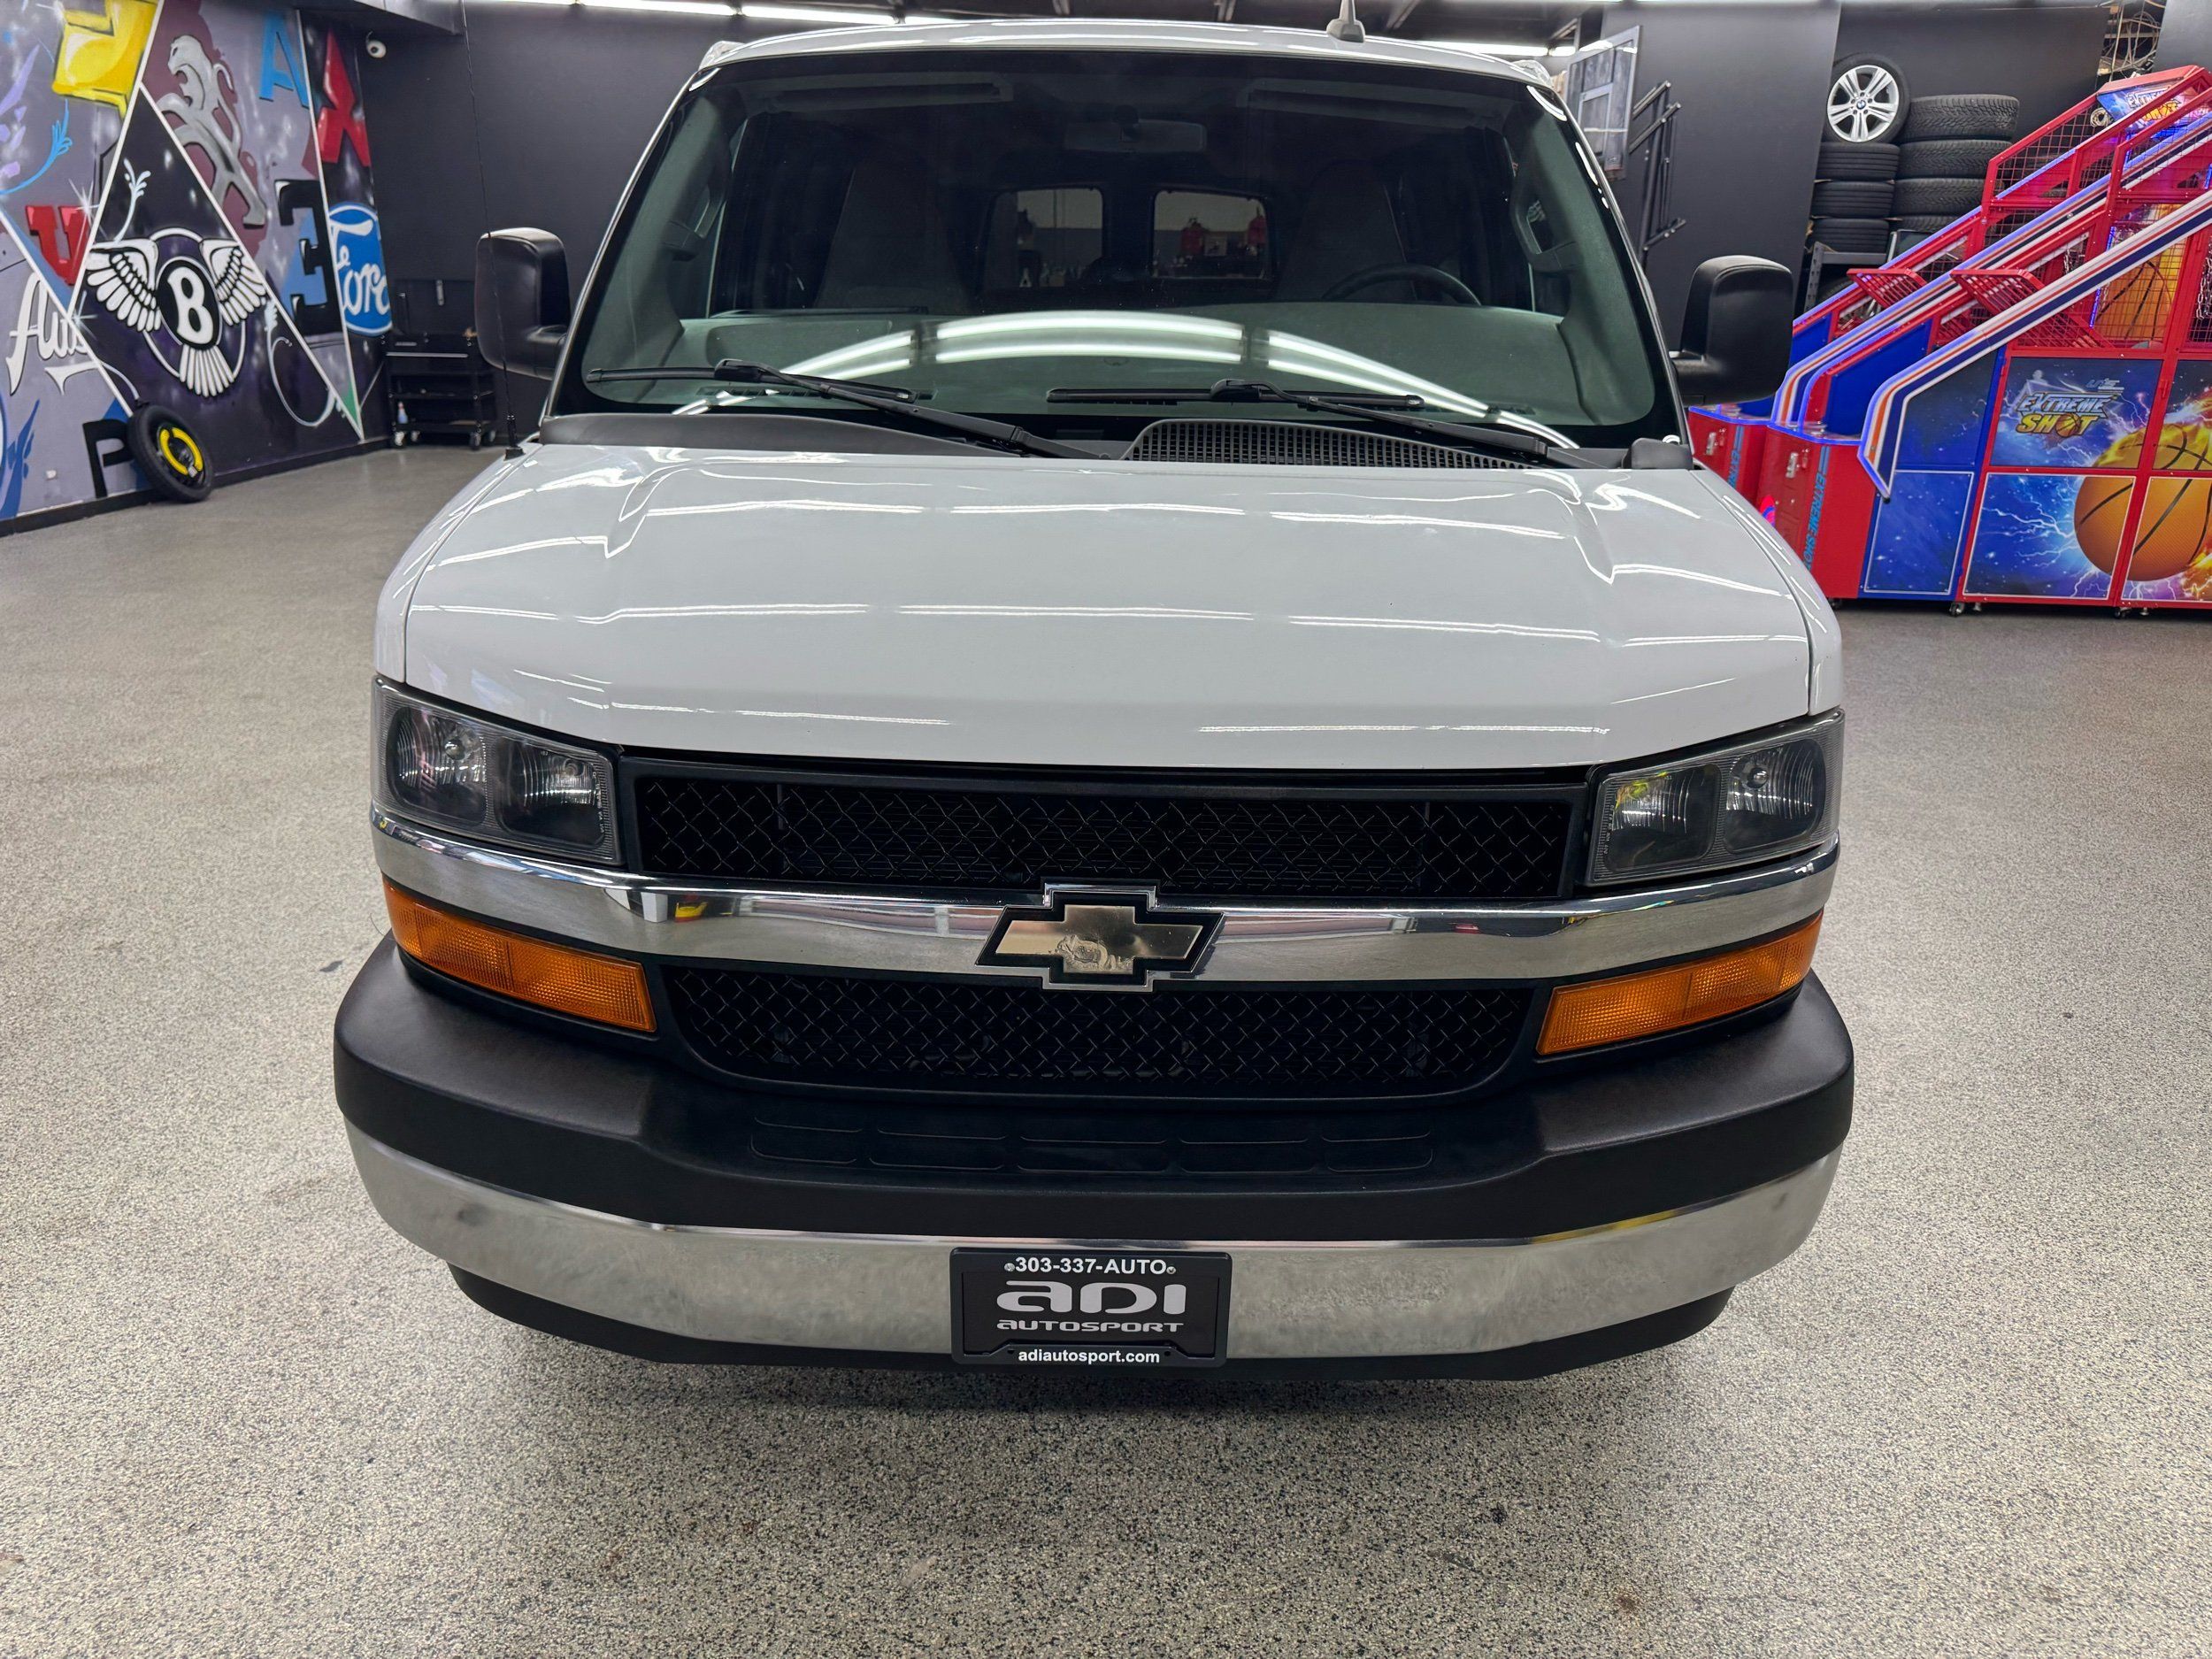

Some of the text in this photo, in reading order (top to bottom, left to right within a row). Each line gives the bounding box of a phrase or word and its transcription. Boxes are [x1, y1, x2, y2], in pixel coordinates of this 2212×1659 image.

[167, 266, 214, 345] B
[2016, 392, 2111, 414] EXTREME
[2016, 412, 2101, 438] SHOT
[1015, 1257, 1167, 1274] 303-337-AUTO
[1018, 1349, 1160, 1364] adiautosport.com
